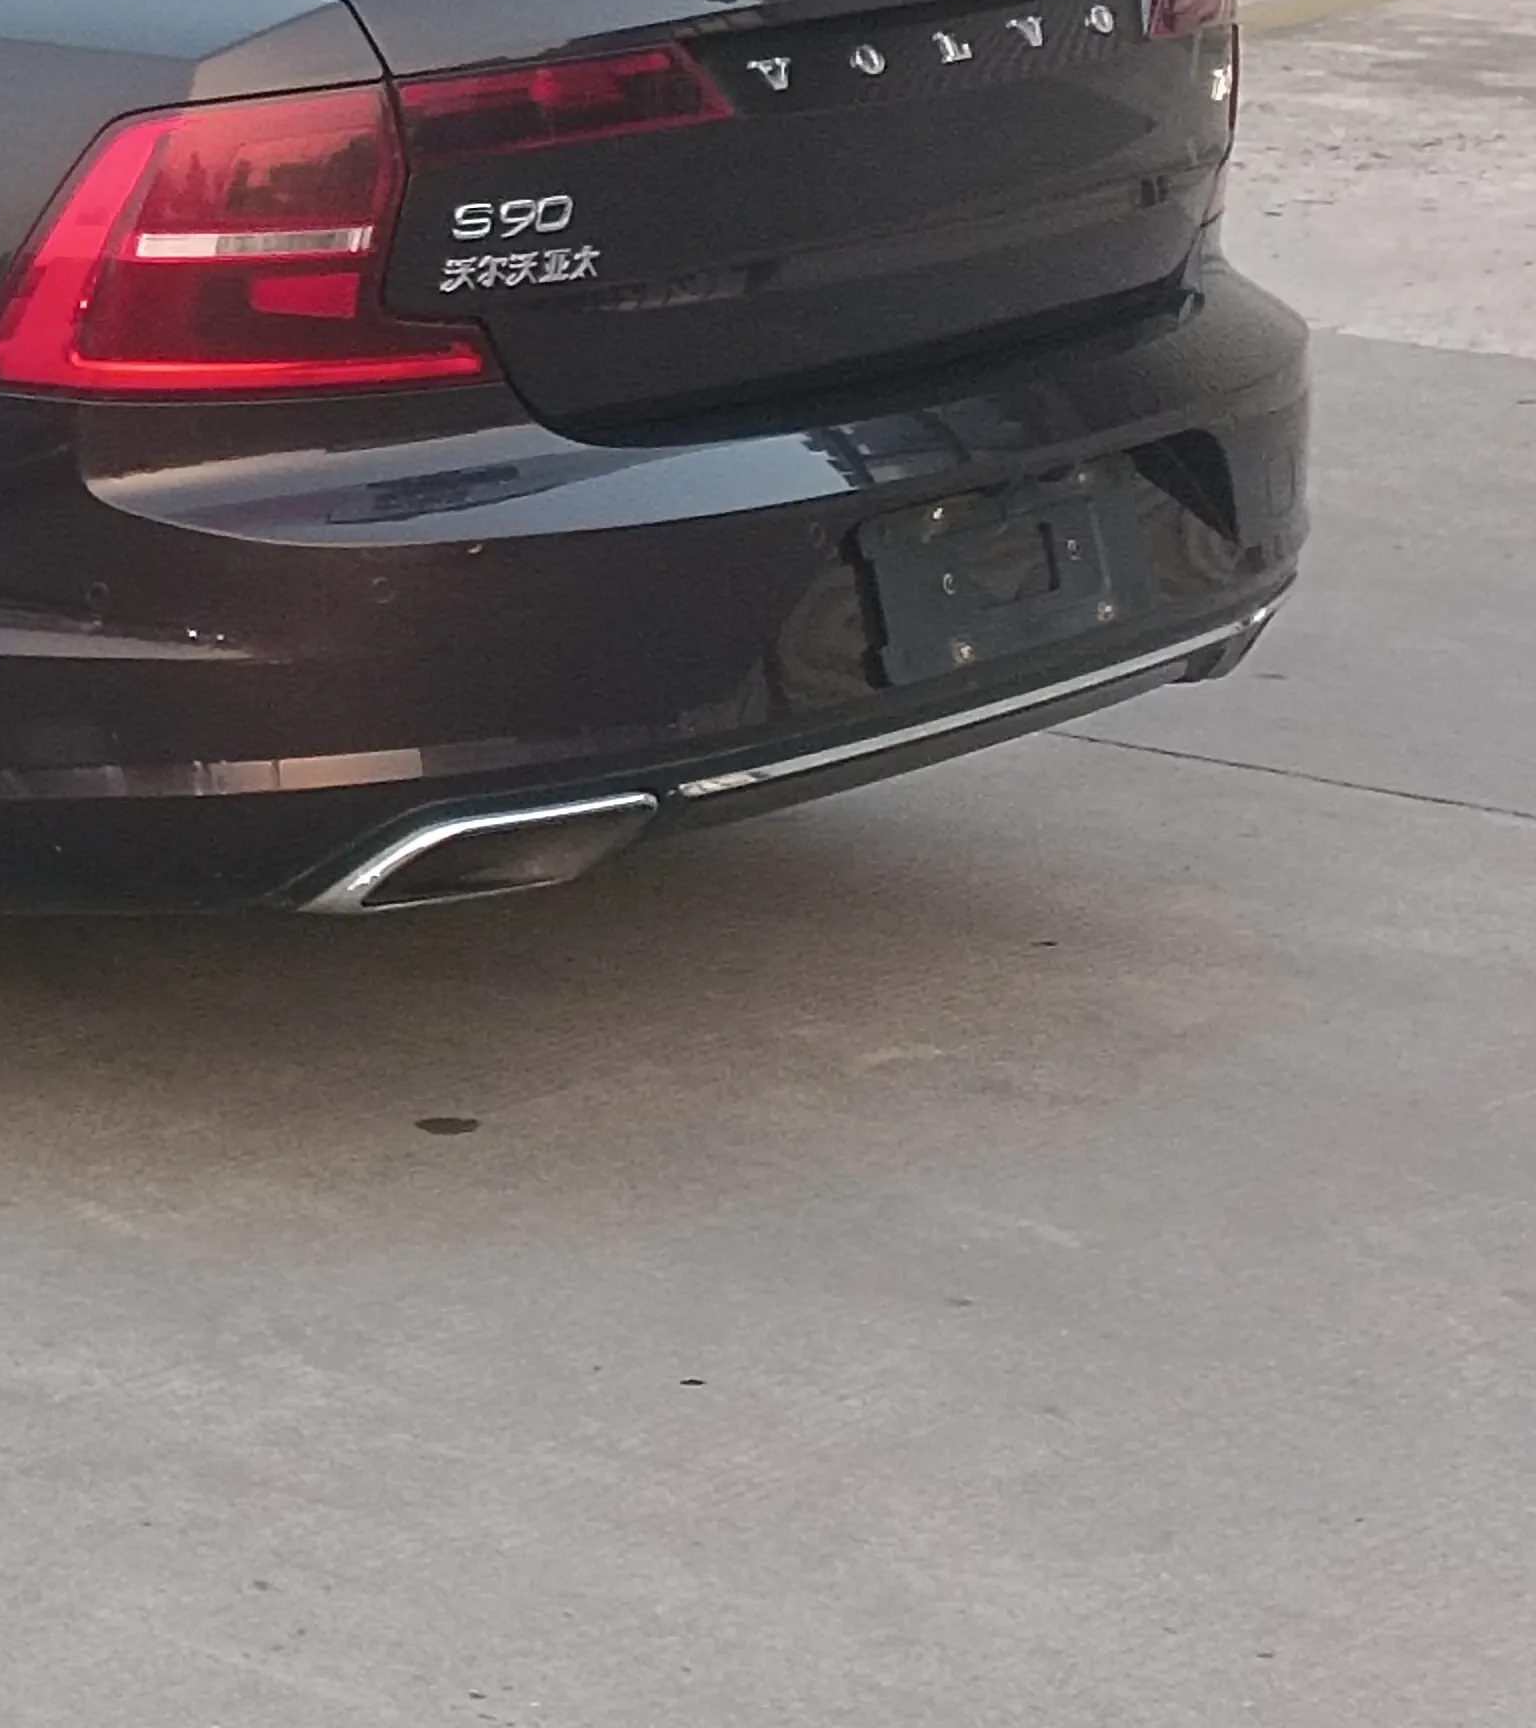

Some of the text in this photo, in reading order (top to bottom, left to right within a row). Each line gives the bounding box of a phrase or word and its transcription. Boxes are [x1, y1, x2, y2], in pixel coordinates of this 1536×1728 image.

[746, 3, 1115, 91] VOLVO
[451, 194, 574, 241] S90
[438, 243, 601, 294] 沃尔沃亚太
